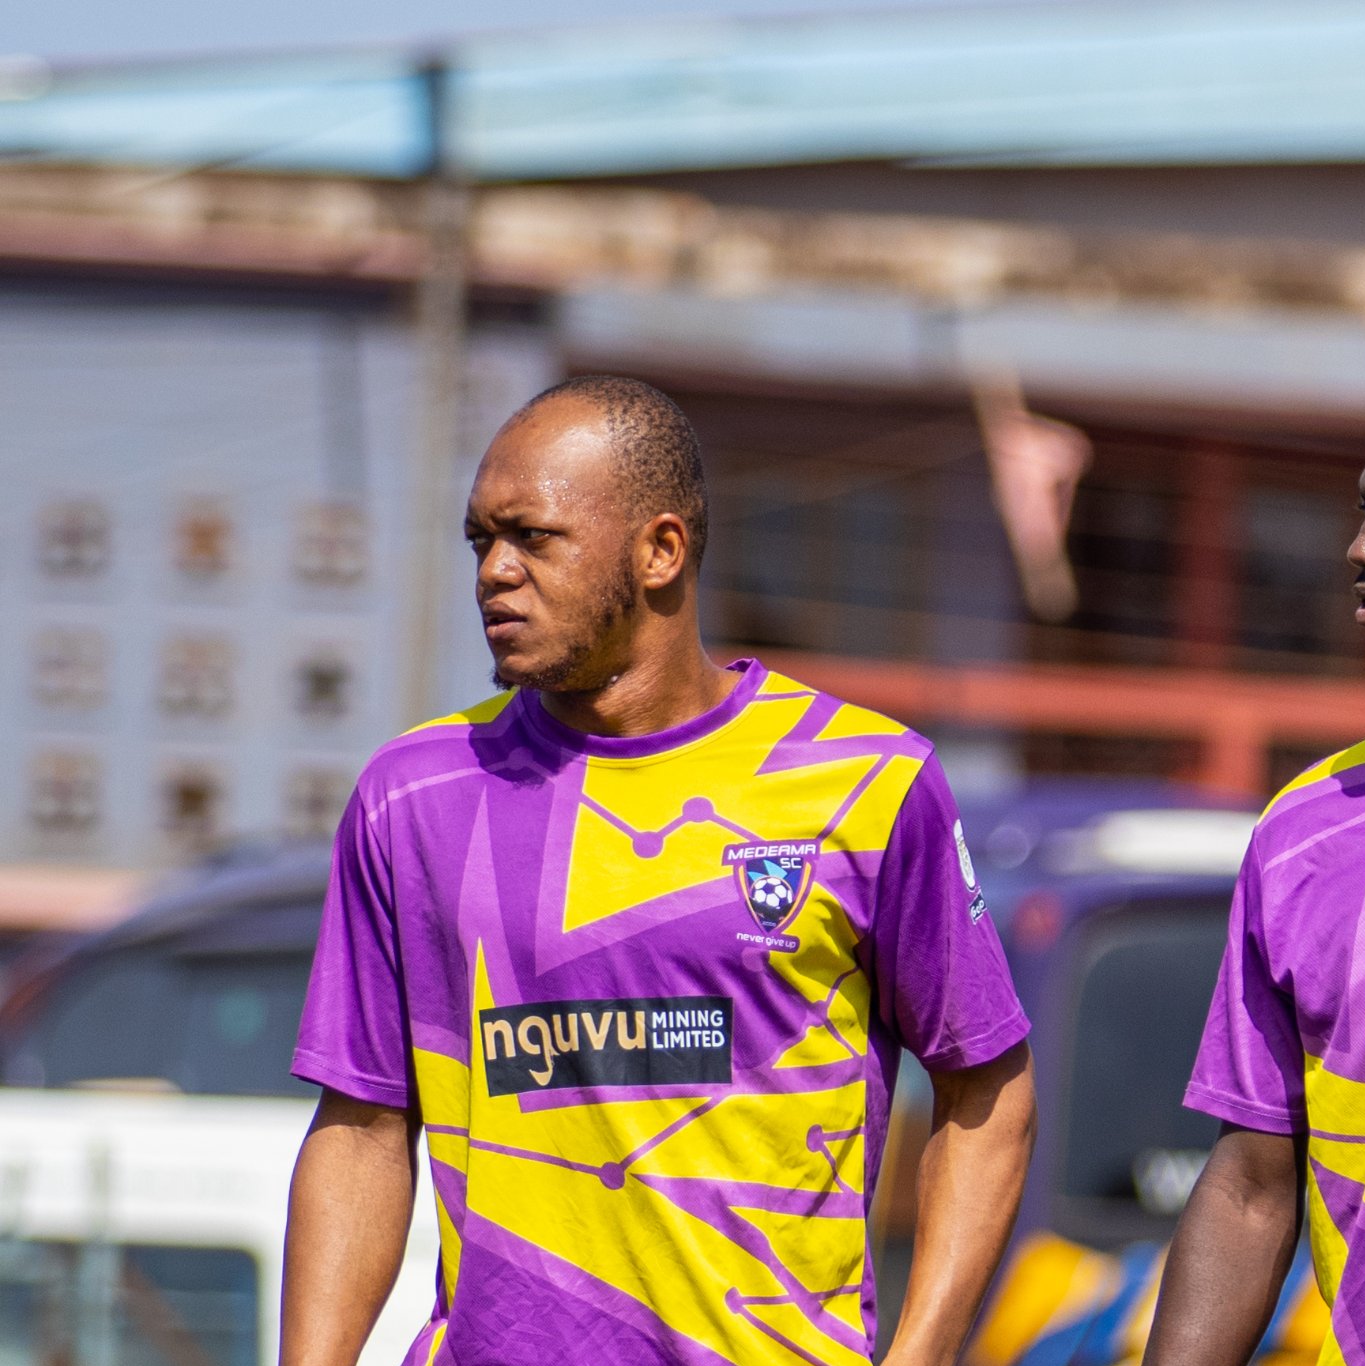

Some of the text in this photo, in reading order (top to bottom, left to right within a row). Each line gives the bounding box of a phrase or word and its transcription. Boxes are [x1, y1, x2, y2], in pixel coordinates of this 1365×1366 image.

[728, 844, 816, 860] MEDEAMA
[780, 857, 802, 869] SC
[736, 932, 797, 949] never give up
[652, 1010, 724, 1029] MINING
[483, 1010, 647, 1087] nguvu
[652, 1030, 725, 1049] LIMITED
